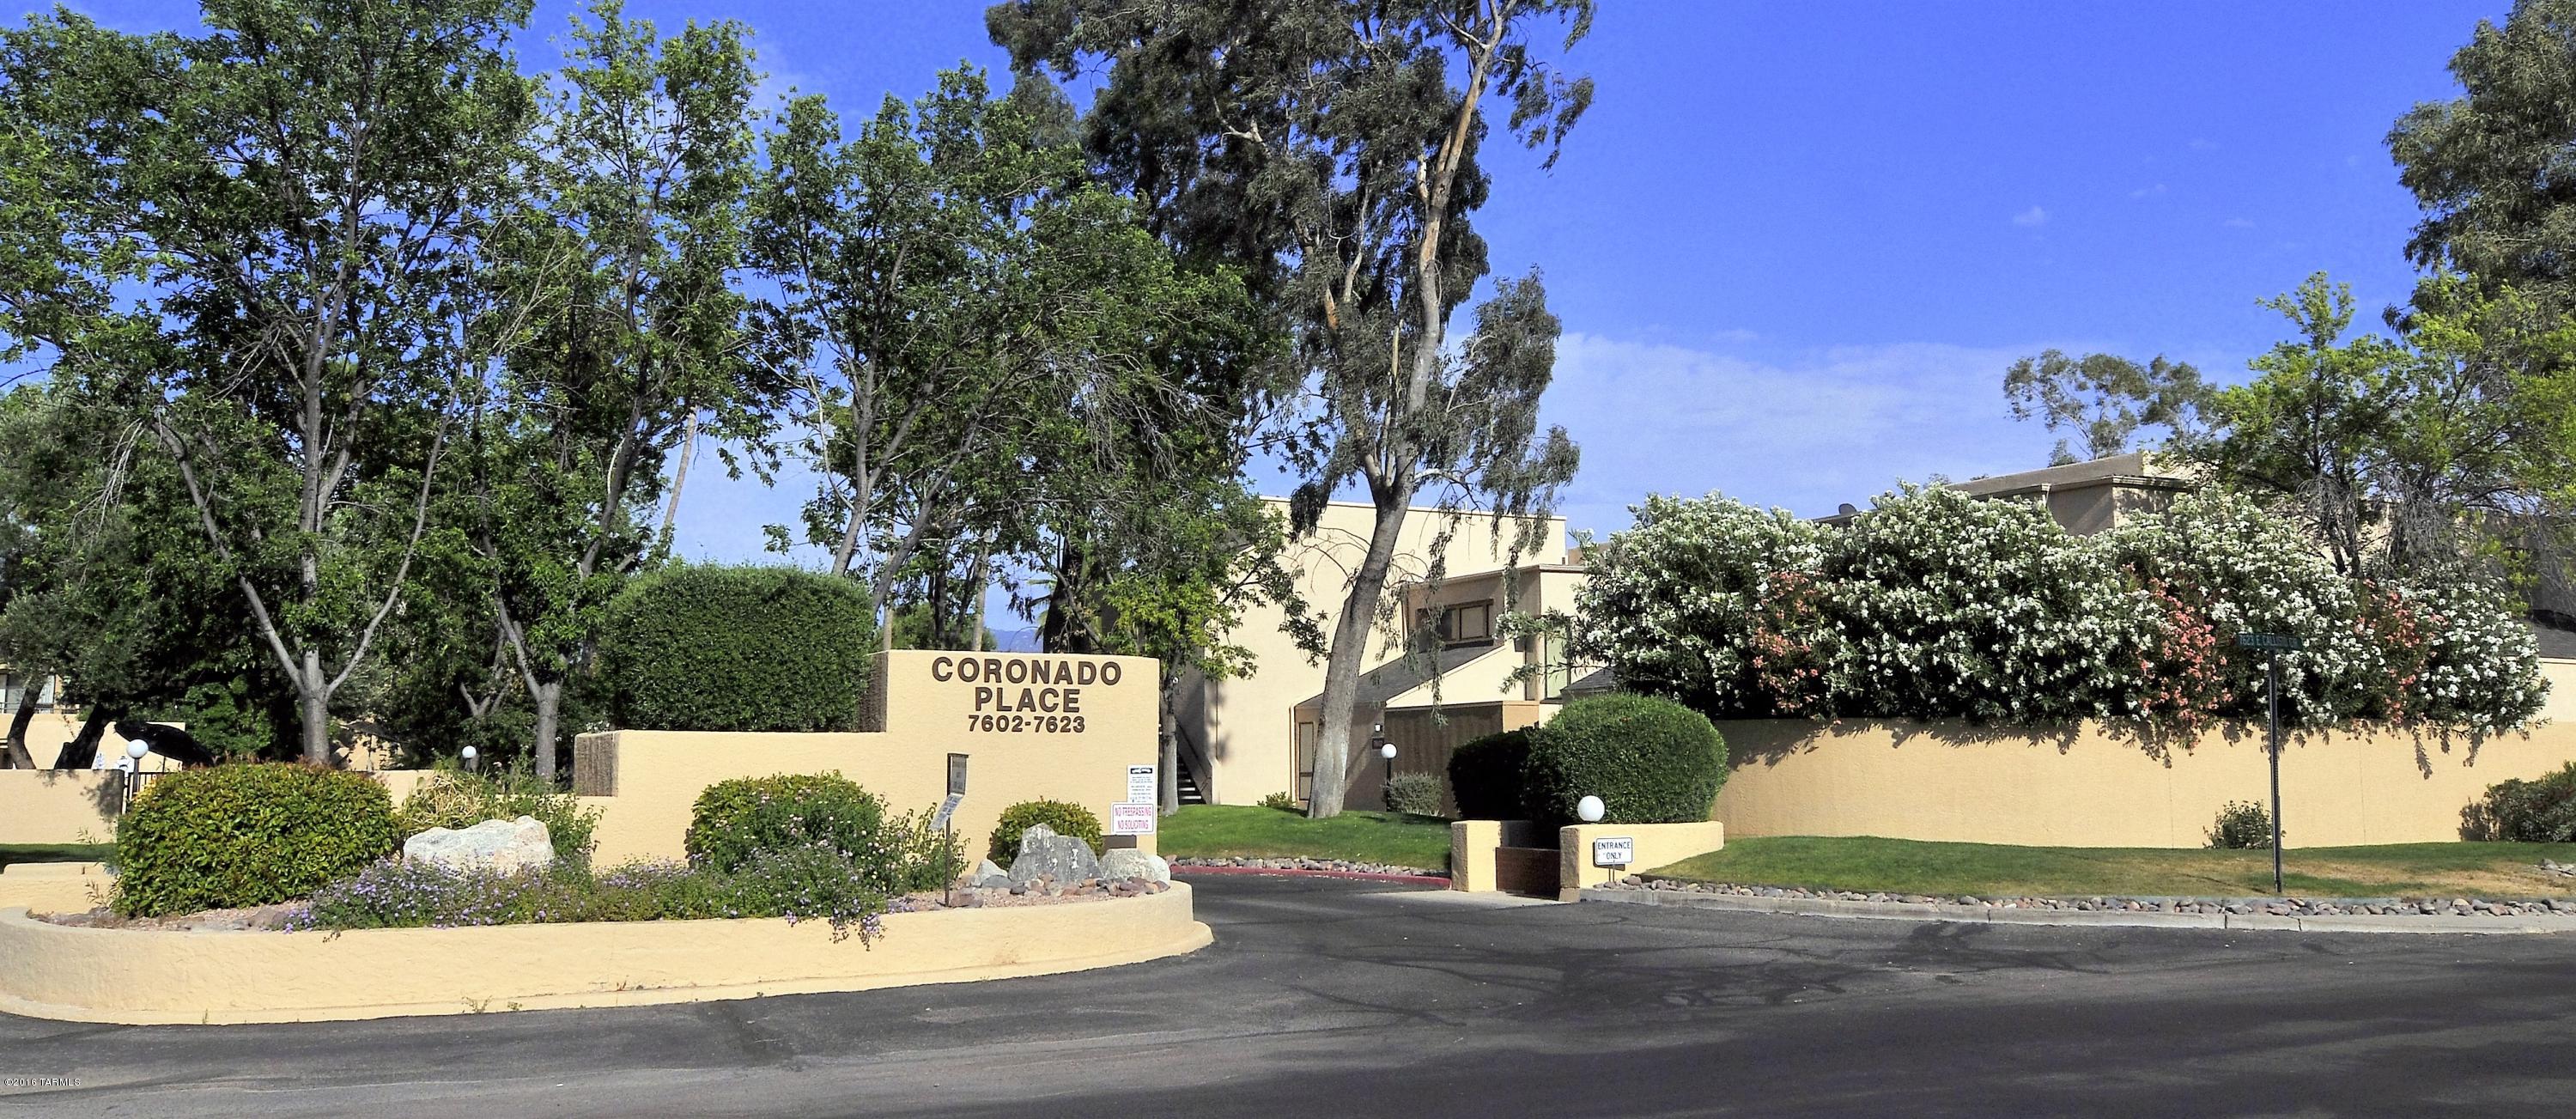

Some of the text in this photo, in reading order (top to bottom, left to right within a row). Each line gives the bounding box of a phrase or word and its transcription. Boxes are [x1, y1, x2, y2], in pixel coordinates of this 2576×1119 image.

[932, 656, 1121, 686] CORONADO
[975, 686, 1080, 713] PLACE
[968, 715, 1085, 733] 7602-7623
[1115, 806, 1151, 817] NO TRESPASSING
[1117, 819, 1149, 830] NO SOLICITING
[1597, 842, 1631, 850] ENTRANCE
